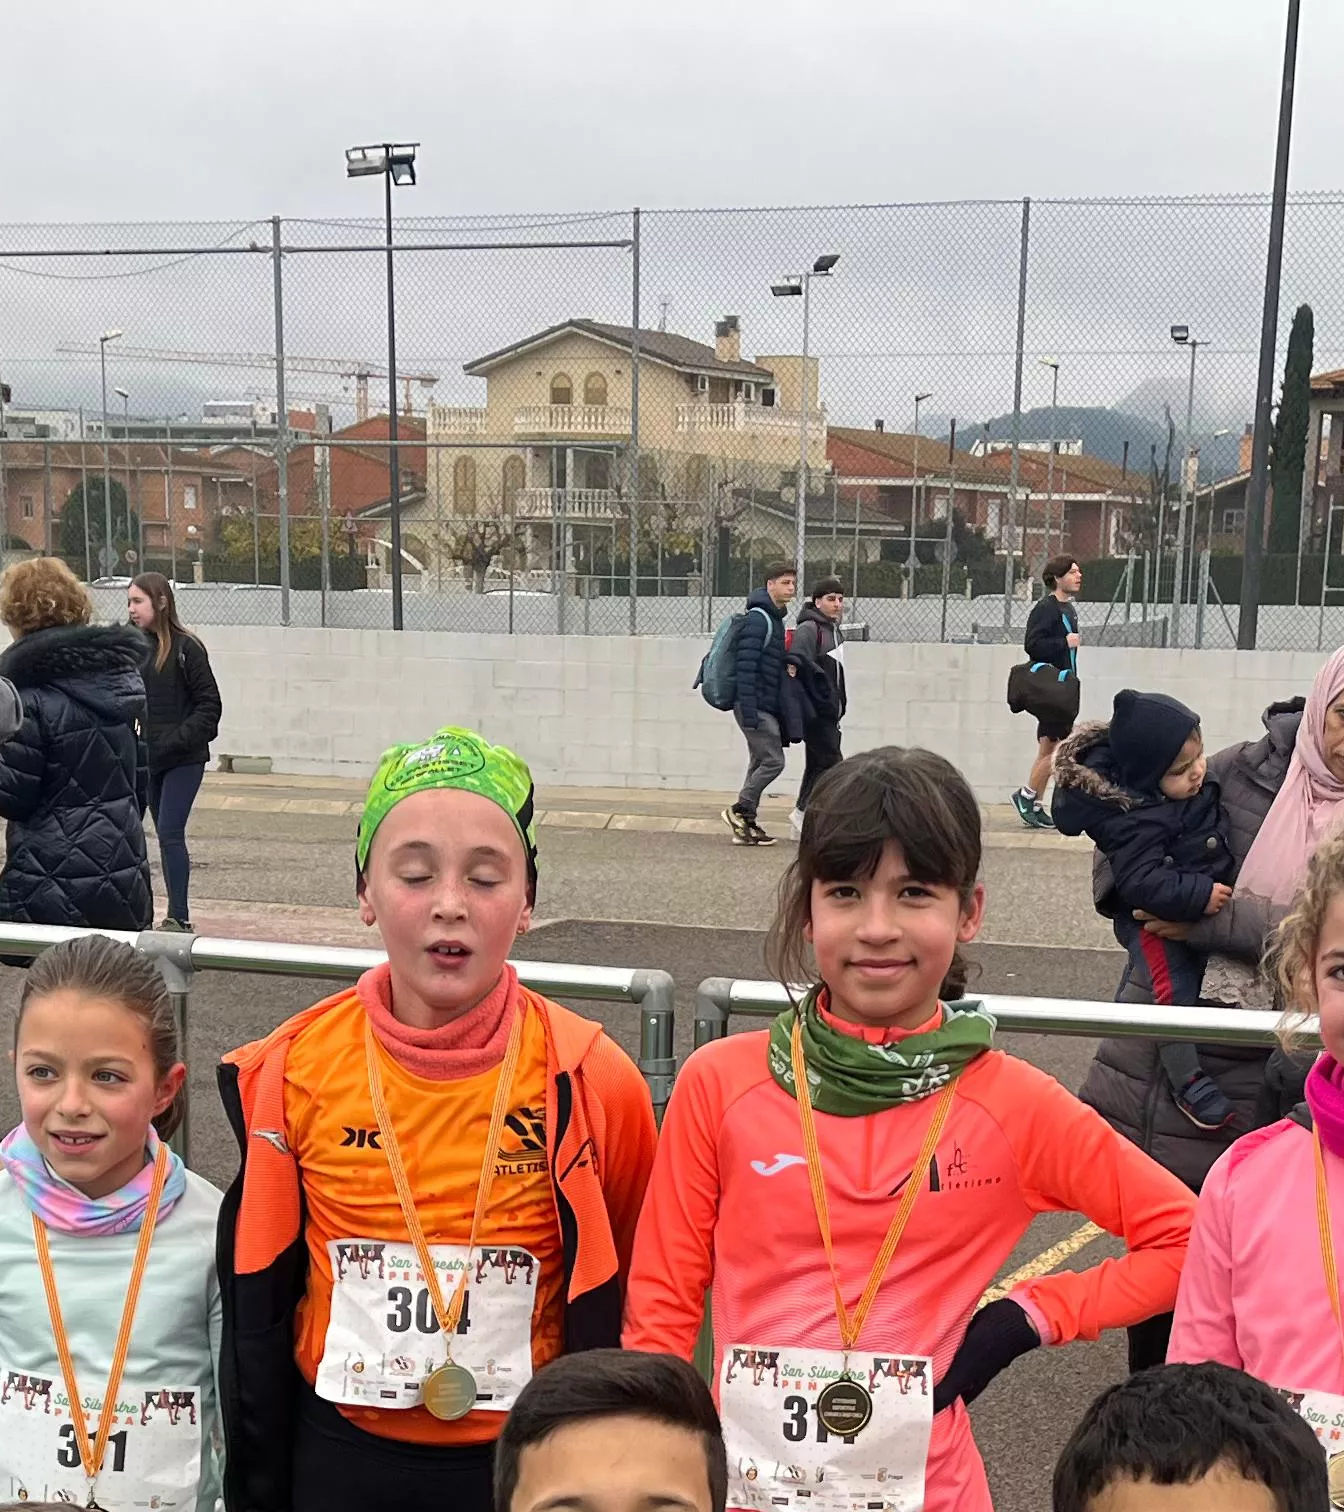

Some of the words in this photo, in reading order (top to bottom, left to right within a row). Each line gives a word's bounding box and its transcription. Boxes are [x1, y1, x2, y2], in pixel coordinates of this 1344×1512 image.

[494, 1161, 548, 1176] ATLETIS
[387, 1255, 413, 1269] San
[780, 1363, 805, 1378] San
[782, 1394, 860, 1445] 31
[1303, 1407, 1329, 1426] San
